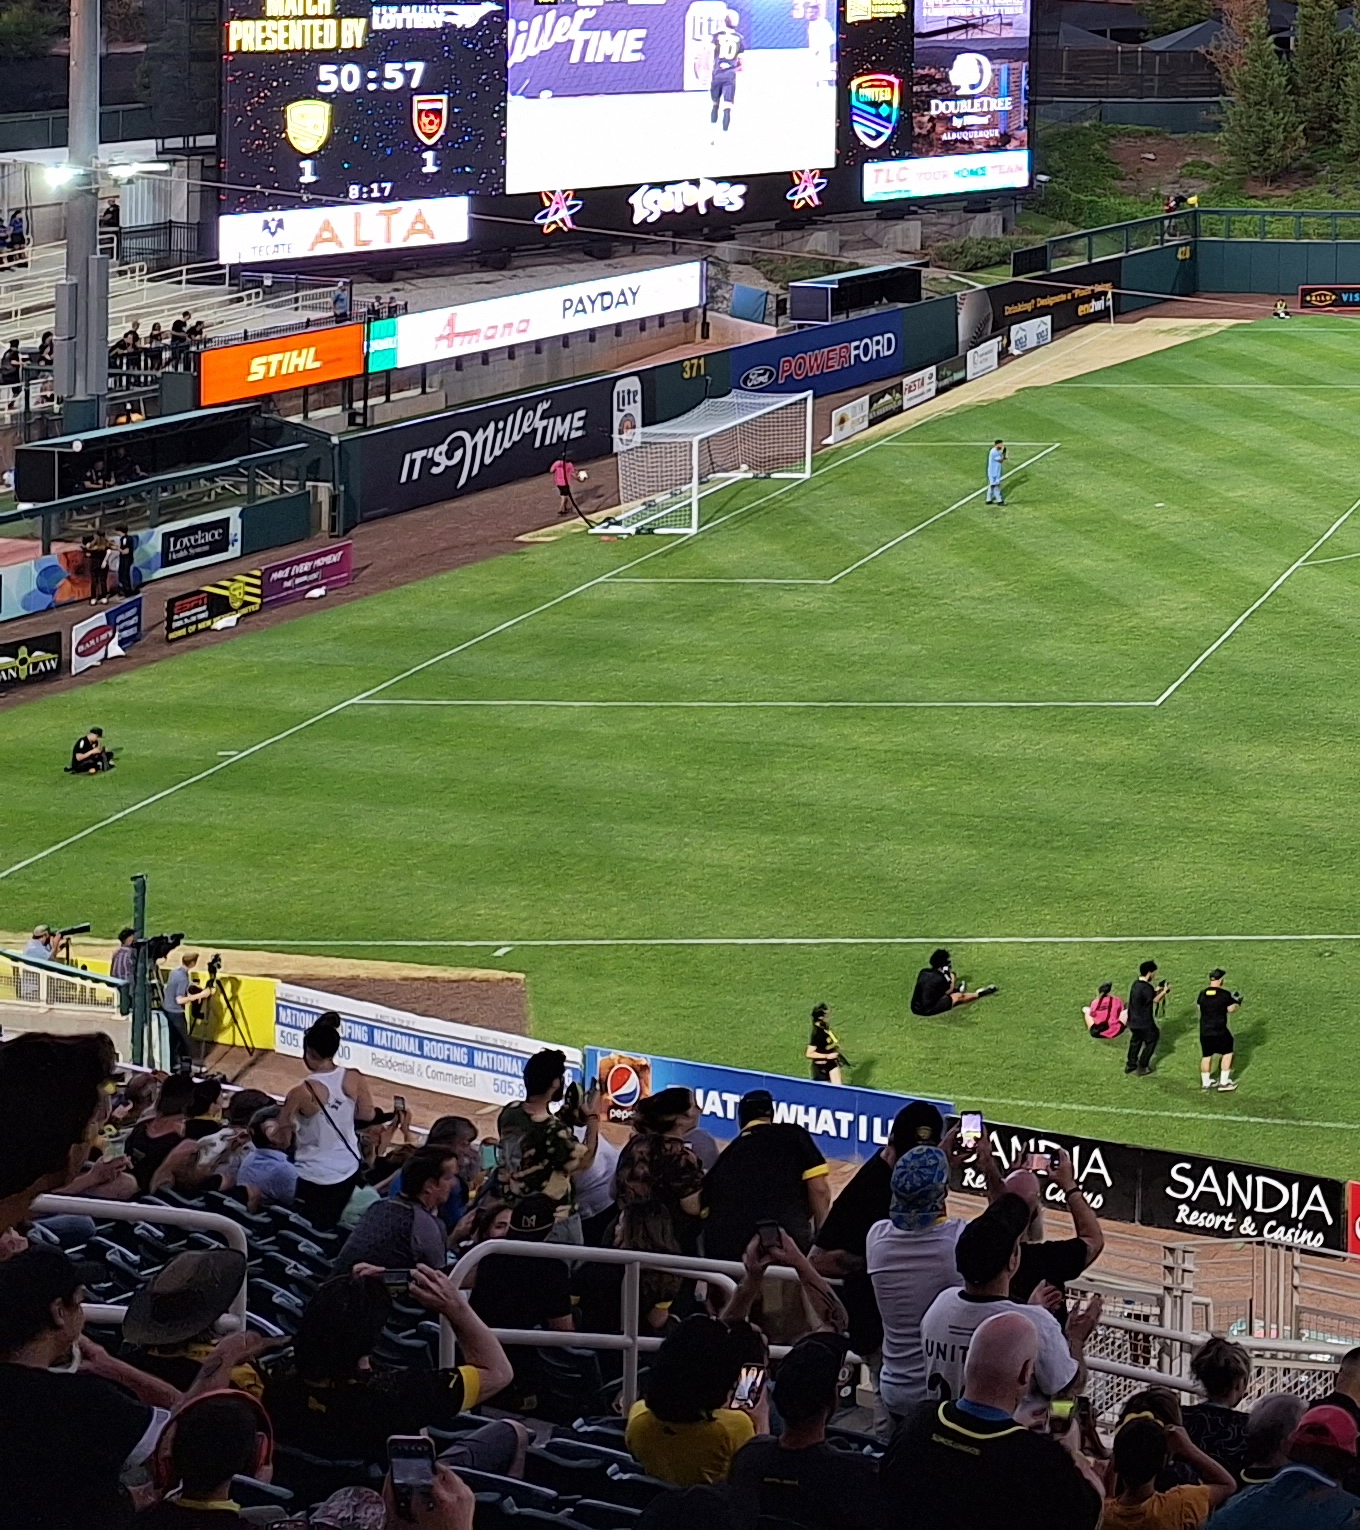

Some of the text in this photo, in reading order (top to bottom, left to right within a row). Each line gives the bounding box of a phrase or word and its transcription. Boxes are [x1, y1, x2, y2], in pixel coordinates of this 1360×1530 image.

[228, 18, 368, 52] PRESENTED BY
[316, 61, 427, 94] 50:57
[299, 158, 319, 183] 1
[421, 150, 441, 174] 1
[872, 165, 909, 185] TLC
[348, 182, 395, 200] 8:17
[628, 177, 748, 225] ISOTOPES
[307, 206, 436, 252] ALTA
[251, 242, 295, 257] TECATE
[433, 311, 531, 352] Amana
[562, 284, 642, 320] PAYDAY
[246, 345, 324, 383] STIHL
[682, 357, 706, 380] 371
[777, 331, 897, 386] POWERFORD
[615, 385, 641, 413] Lite
[399, 398, 589, 491] IT'S Miller TIME
[168, 526, 224, 553] Lovelace
[313, 549, 345, 568] MOMENT
[29, 657, 60, 676] LAW
[370, 1051, 477, 1088] Residential & Commercial
[373, 1029, 422, 1056] NATIONAL
[423, 1042, 469, 1065] ROOFING
[473, 1052, 525, 1076] NATIONAL
[772, 1100, 869, 1143] WHAT I
[1165, 1160, 1335, 1226] SANDIA
[1175, 1202, 1236, 1233] Resort
[1239, 1216, 1258, 1237] &
[1262, 1219, 1326, 1249] Casino
